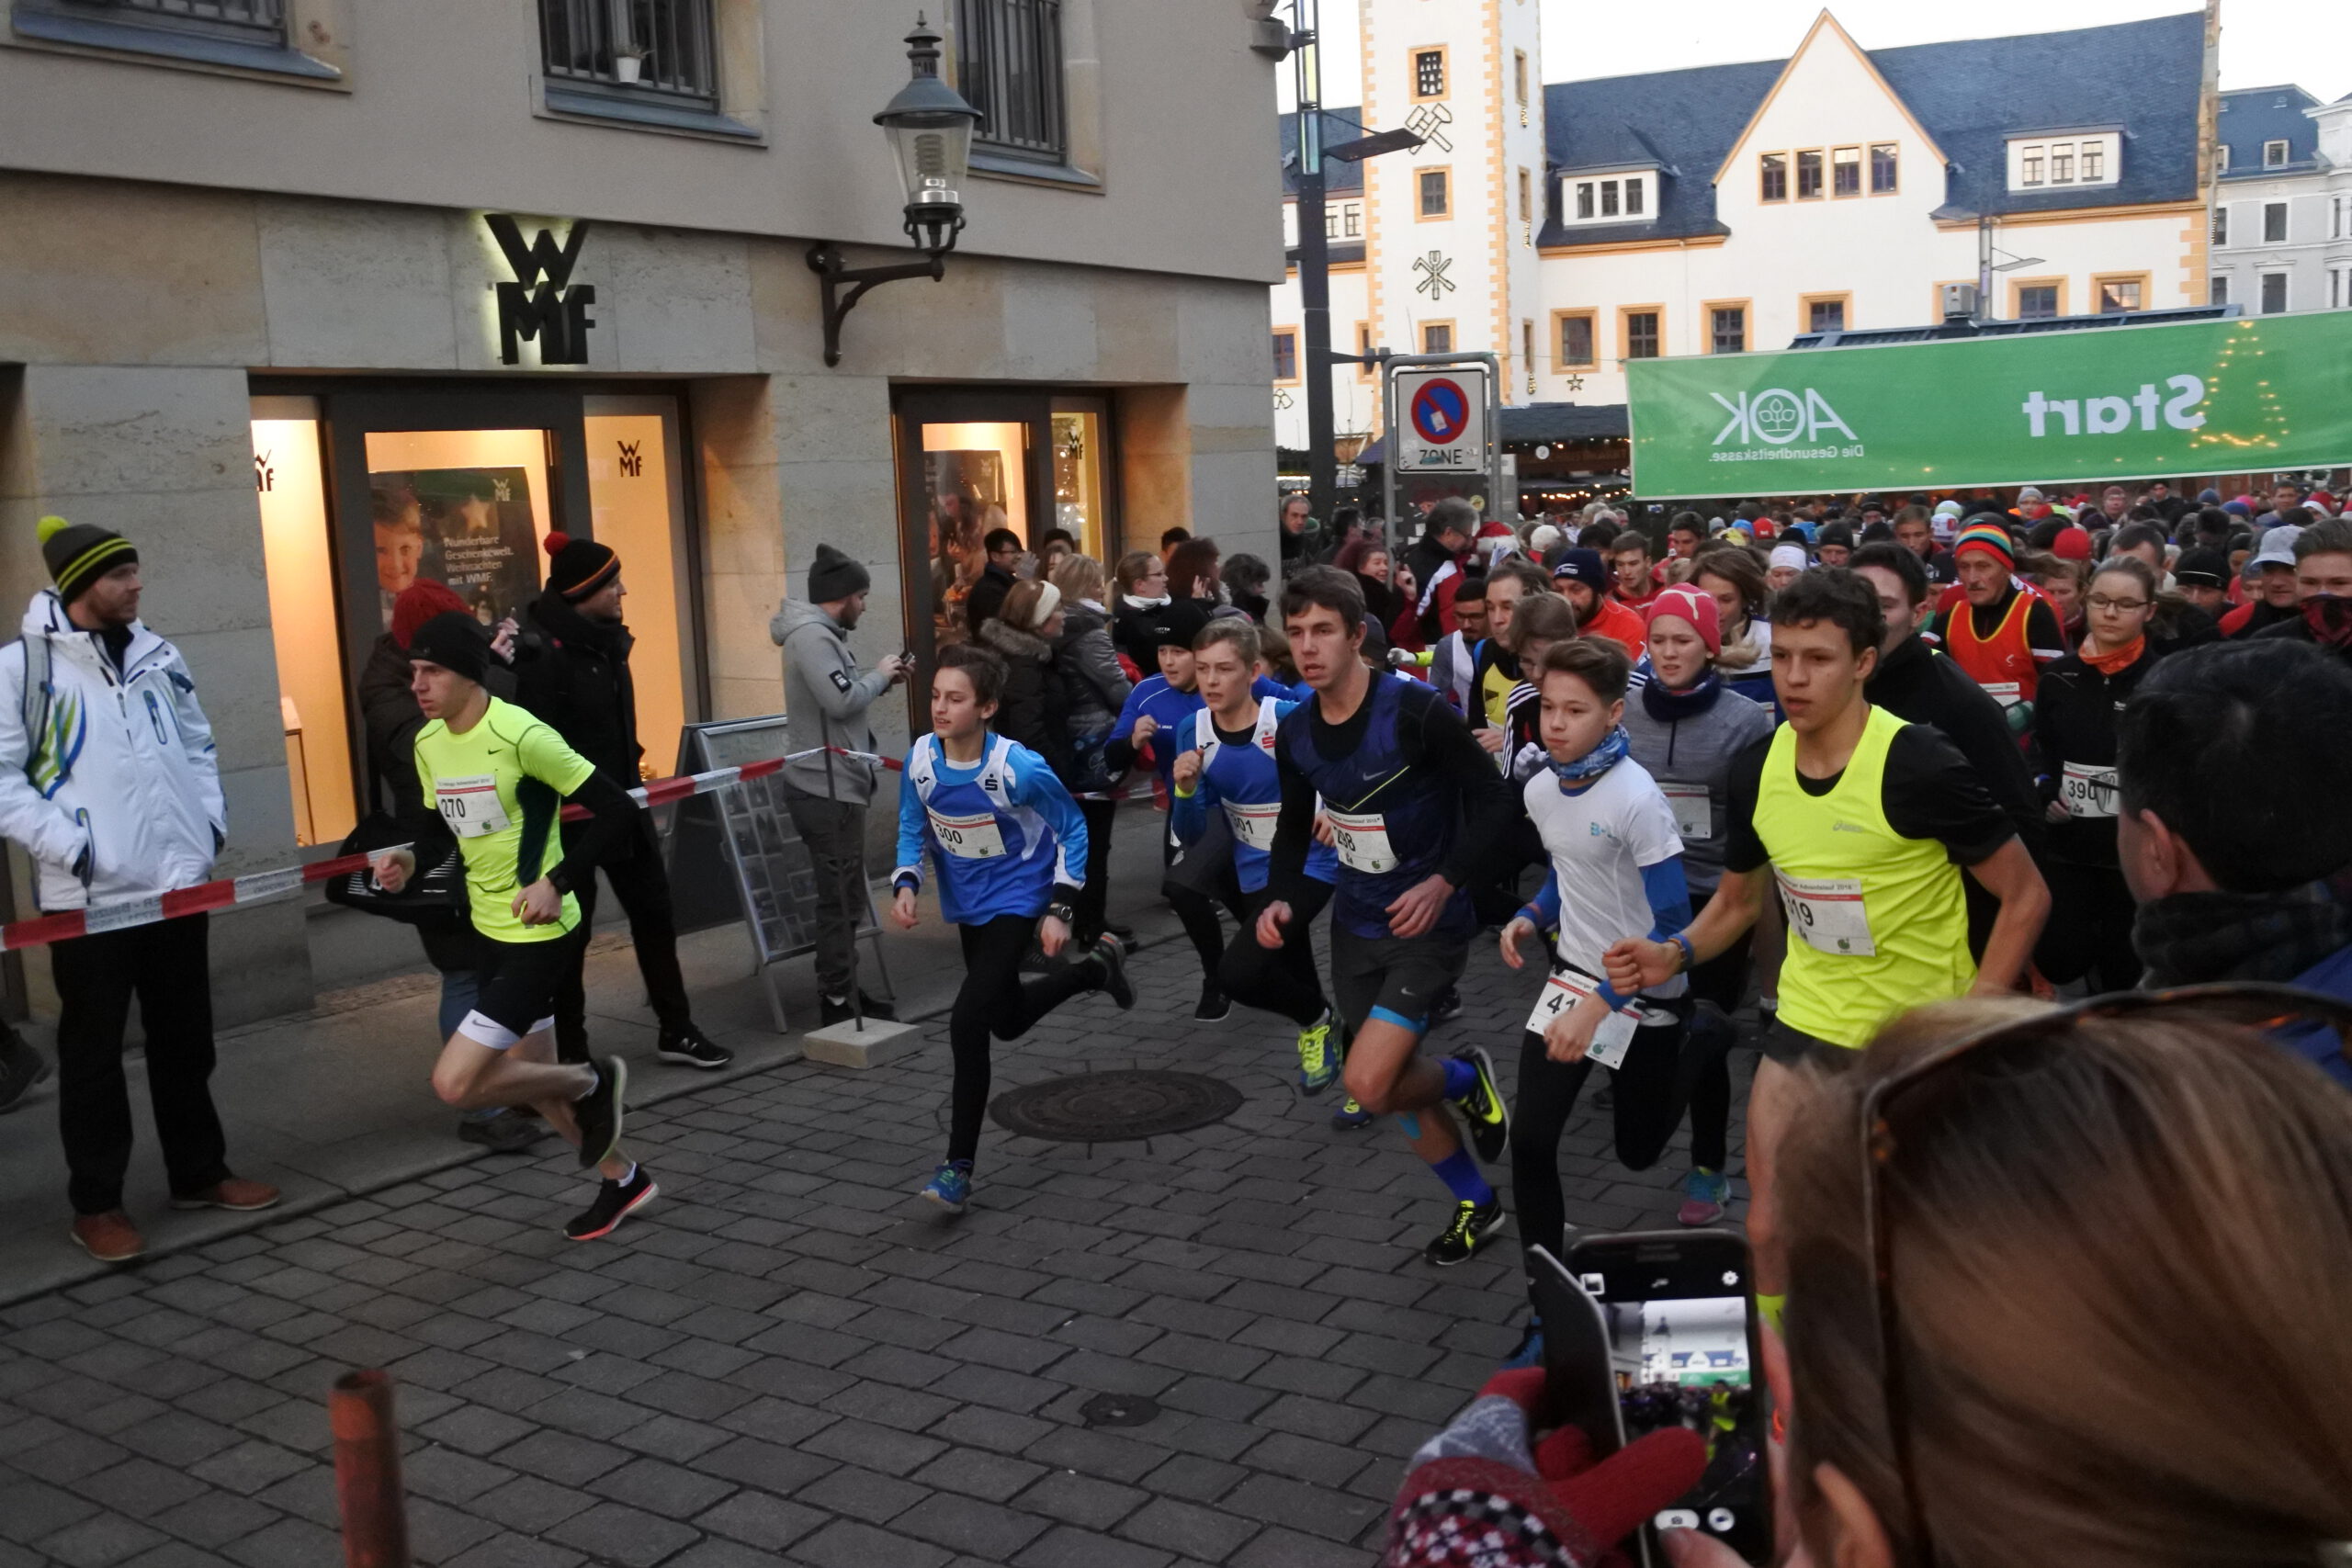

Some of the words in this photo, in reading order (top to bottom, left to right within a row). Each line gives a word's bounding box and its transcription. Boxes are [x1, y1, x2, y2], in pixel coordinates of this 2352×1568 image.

[1419, 449, 1463, 465] ZONE
[448, 576, 463, 585] mit
[2068, 780, 2097, 800] 390
[441, 798, 466, 818] 270
[935, 823, 963, 844] 300
